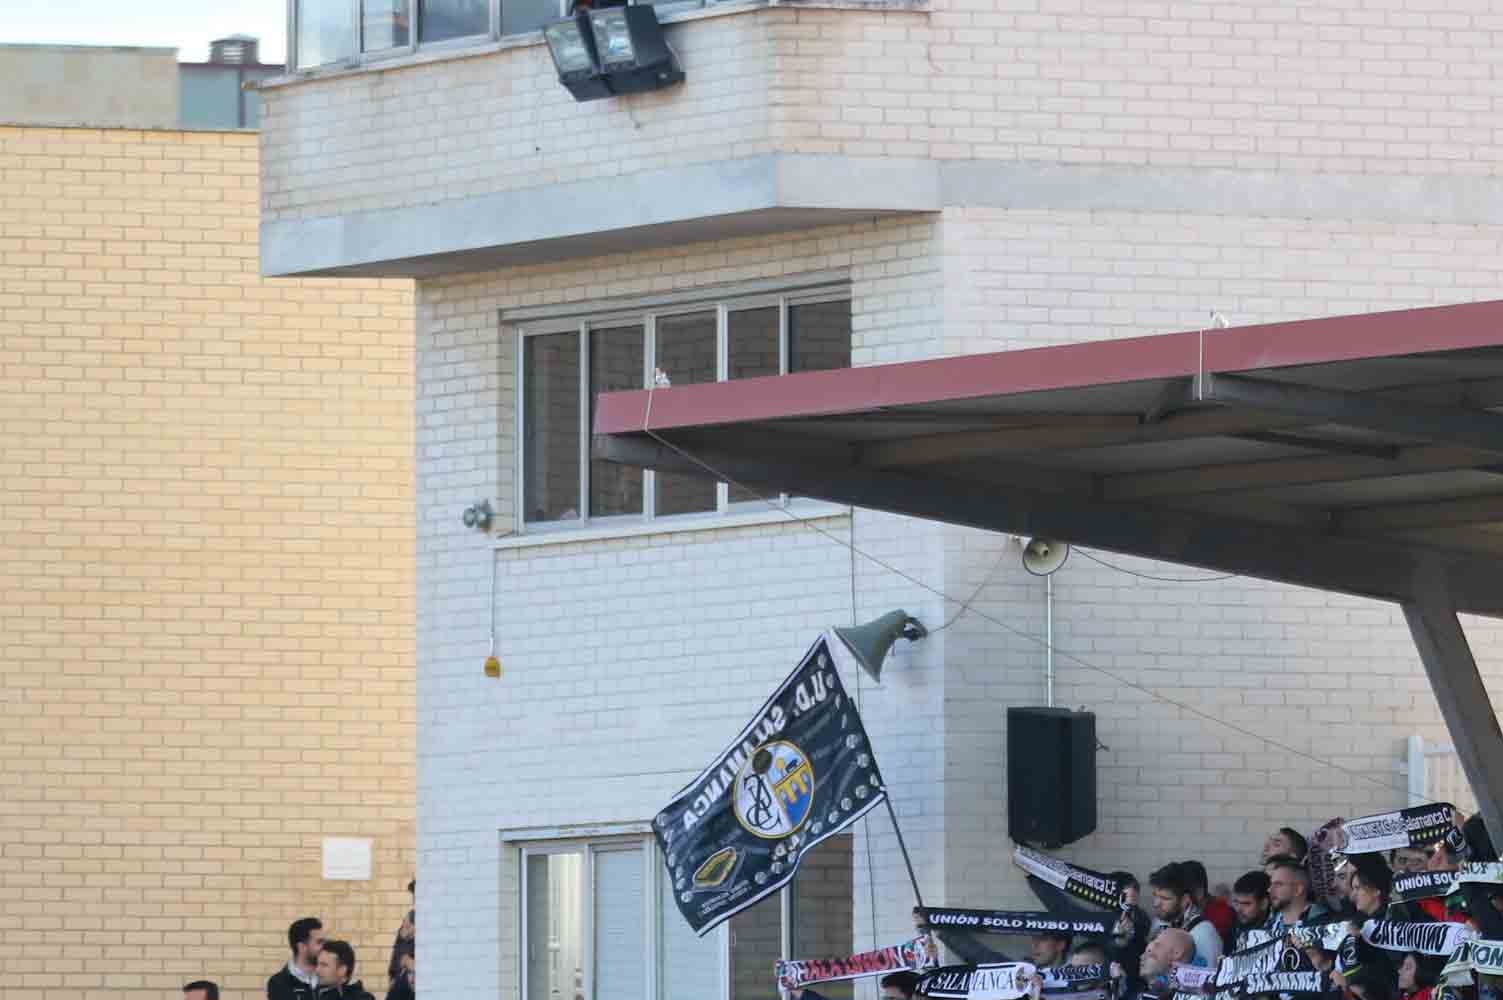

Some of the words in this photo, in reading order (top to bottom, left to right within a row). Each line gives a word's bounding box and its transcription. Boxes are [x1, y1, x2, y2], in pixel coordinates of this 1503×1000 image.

[1396, 875, 1432, 893] UNIÓN
[929, 912, 979, 926] UNIÓN
[983, 916, 1022, 929] SOLO
[1072, 920, 1105, 933] UNA
[930, 966, 1015, 992] SALAMANCA
[1246, 971, 1322, 993] SALAMANCA
